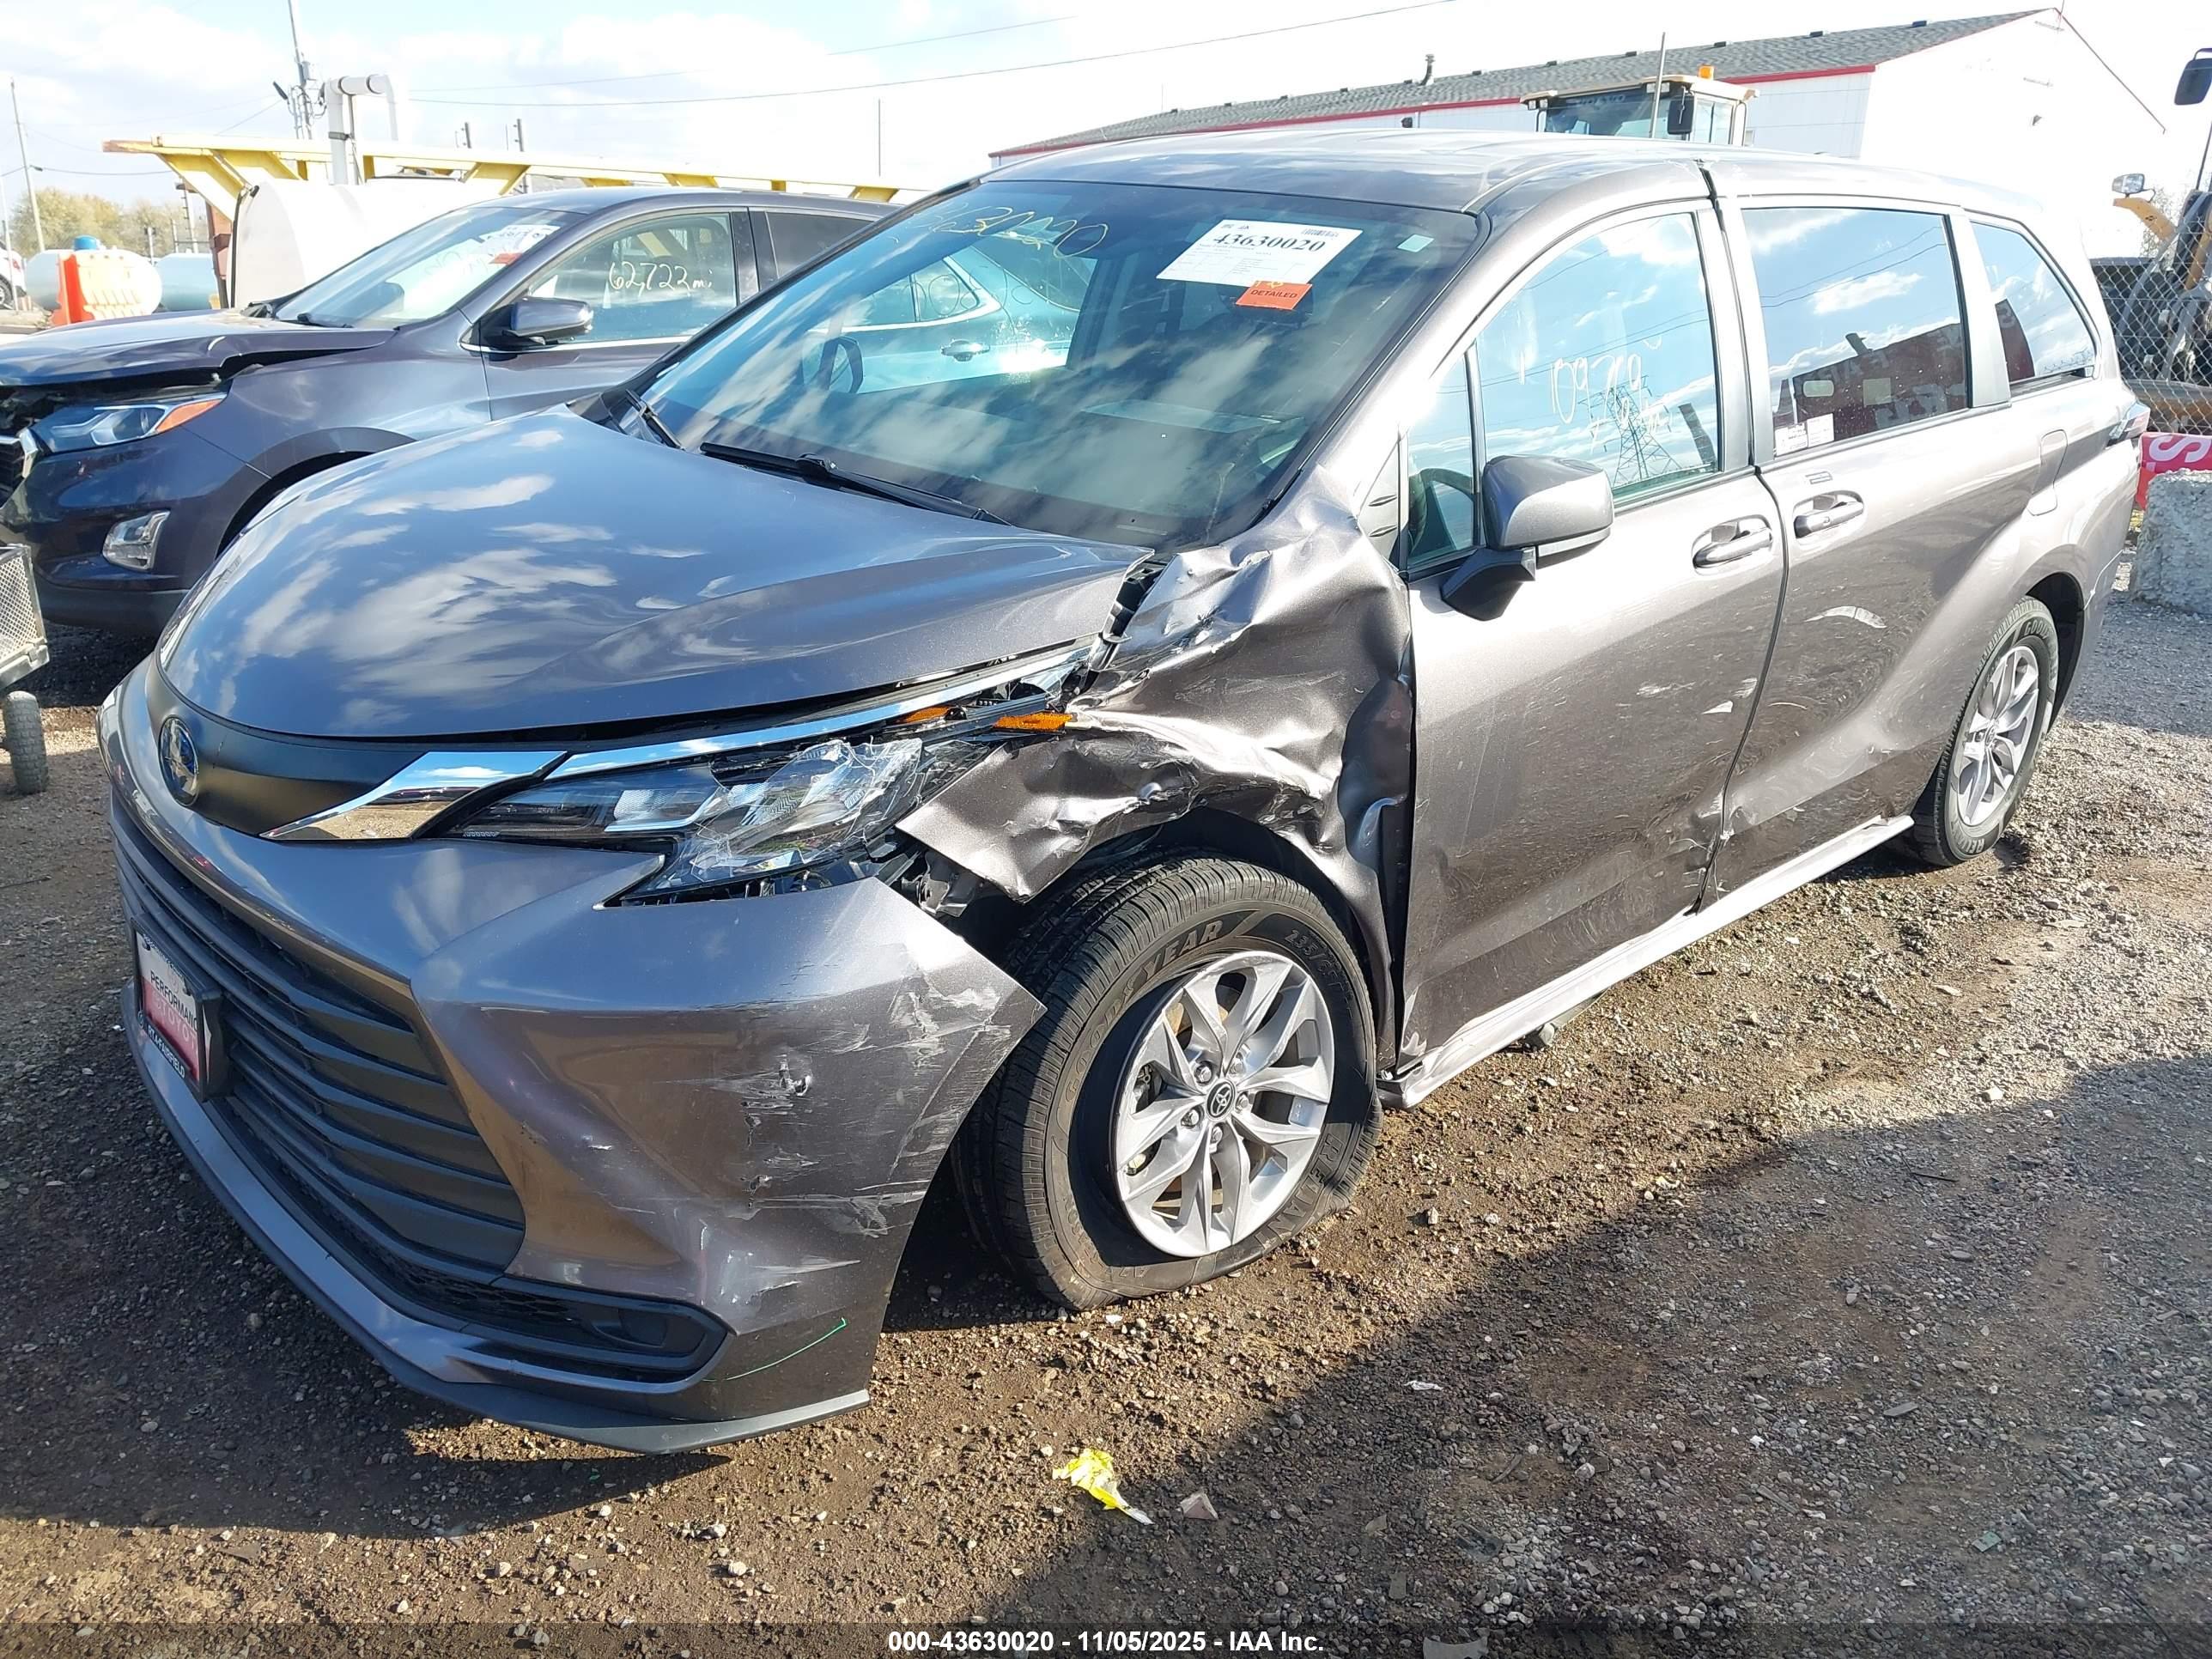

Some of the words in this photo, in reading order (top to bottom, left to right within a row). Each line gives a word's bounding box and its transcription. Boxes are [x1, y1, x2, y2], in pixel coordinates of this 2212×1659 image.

[1213, 233, 1326, 252] 43630020
[1250, 289, 1297, 299] DETAILED
[150, 970, 198, 1032] PERFORMANC
